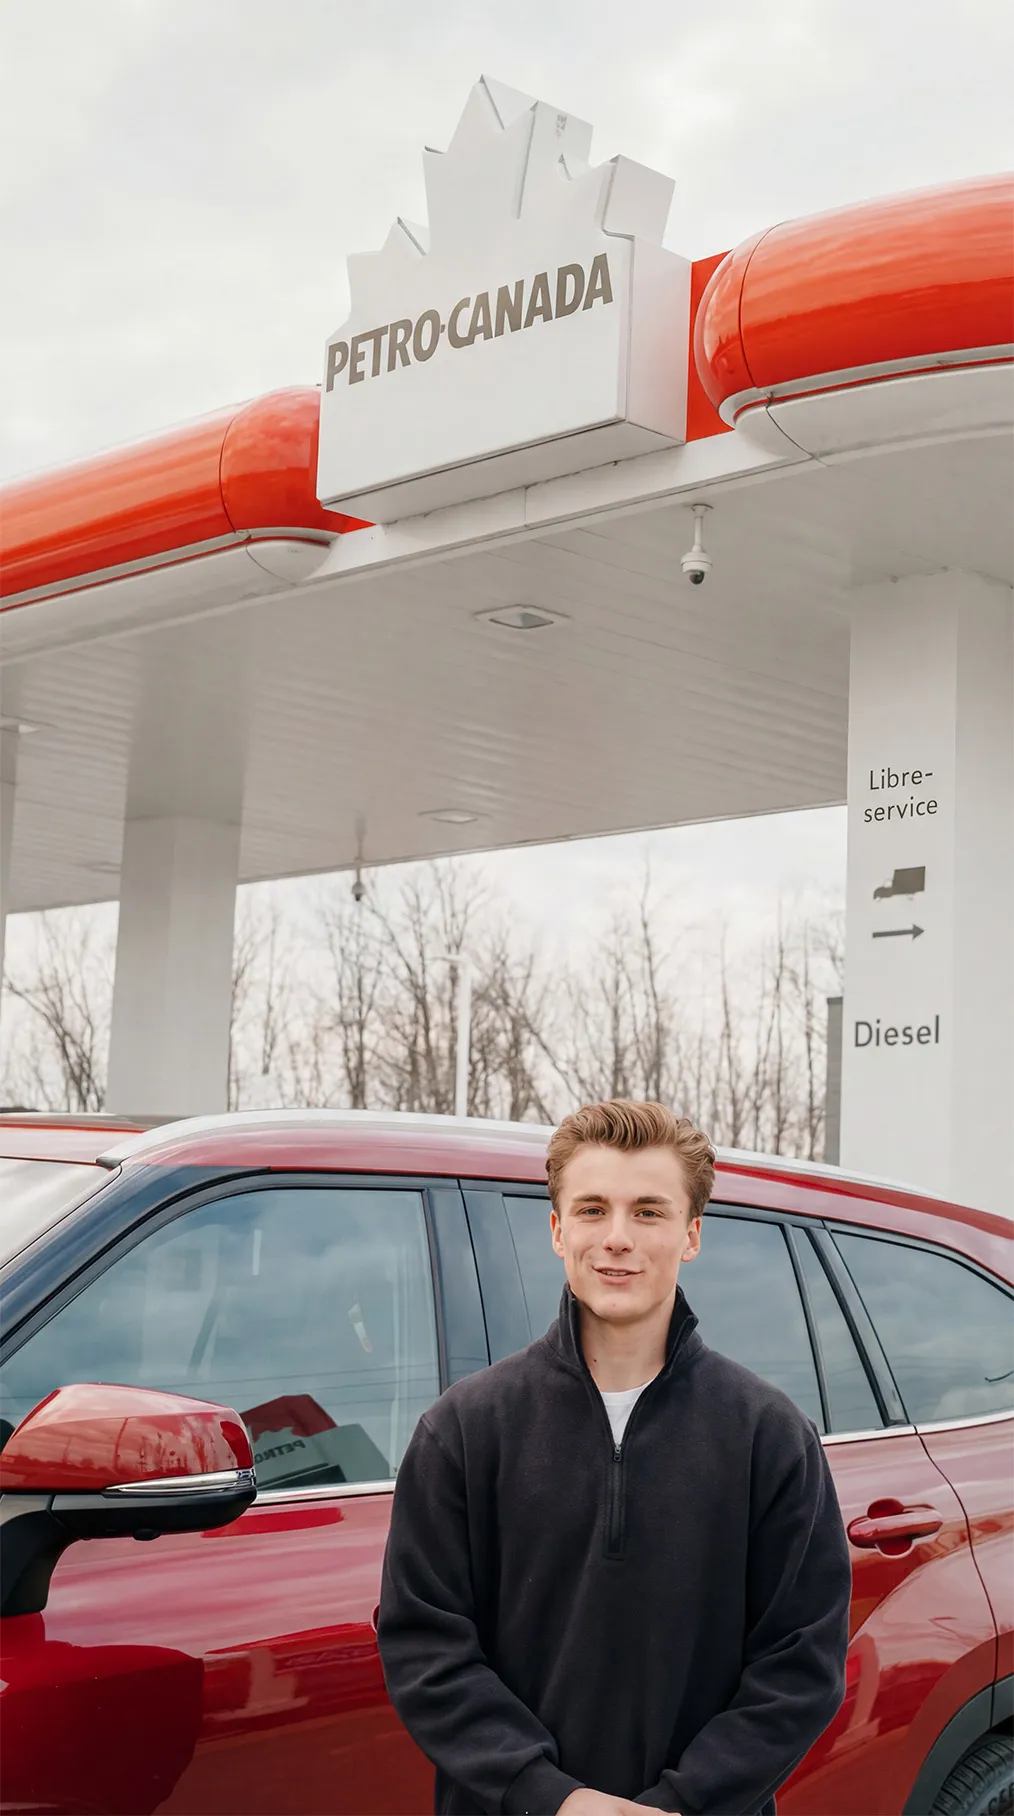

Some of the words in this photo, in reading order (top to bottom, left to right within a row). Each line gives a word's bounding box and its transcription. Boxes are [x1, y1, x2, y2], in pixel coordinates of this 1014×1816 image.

[869, 767, 934, 791] Libre-
[863, 796, 938, 823] service
[854, 1015, 940, 1048] Diesel
